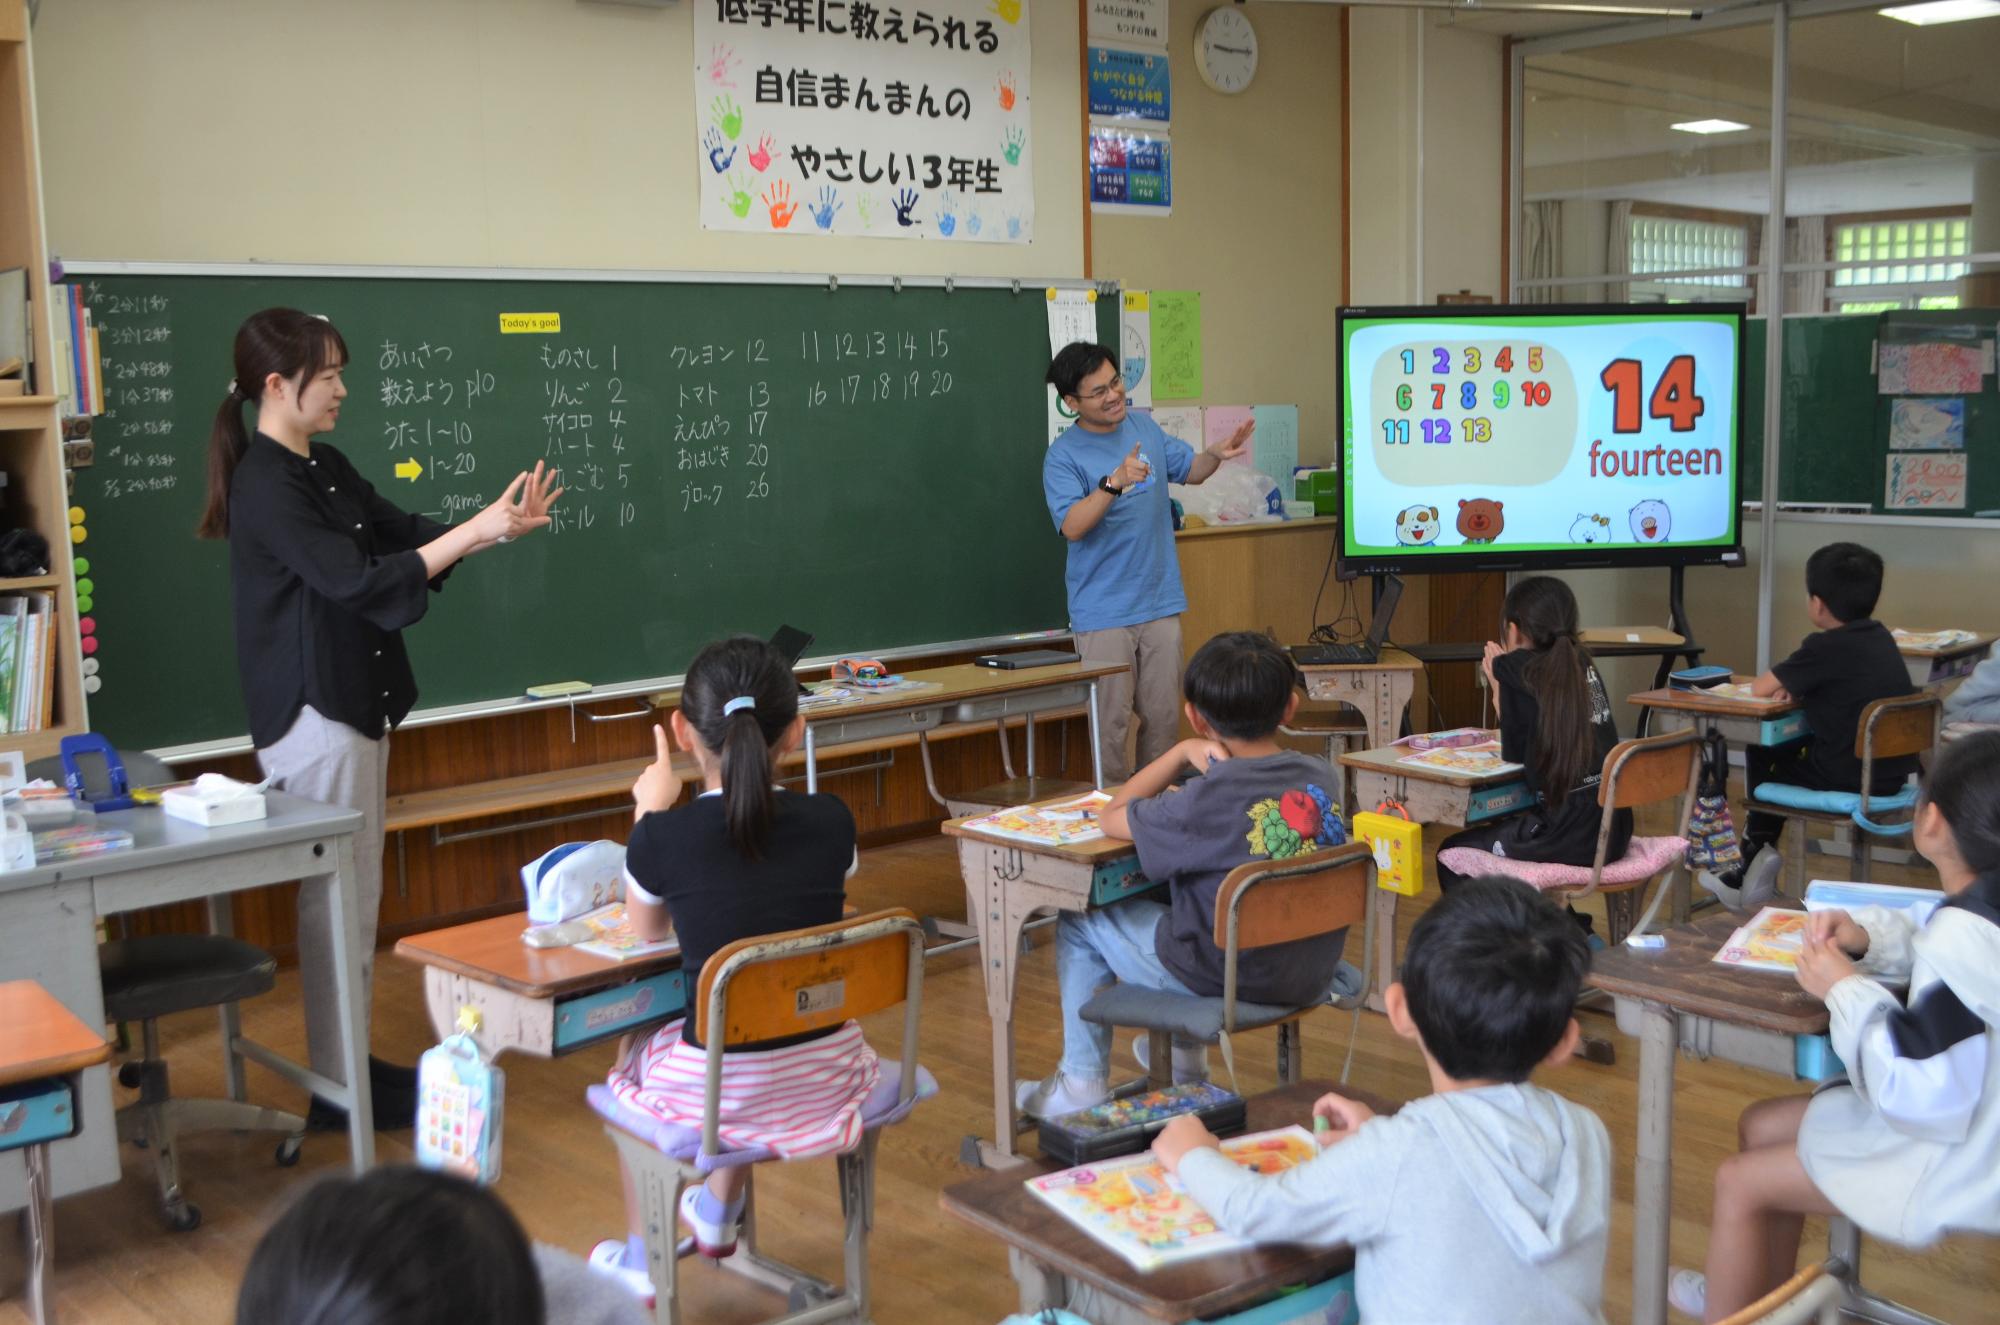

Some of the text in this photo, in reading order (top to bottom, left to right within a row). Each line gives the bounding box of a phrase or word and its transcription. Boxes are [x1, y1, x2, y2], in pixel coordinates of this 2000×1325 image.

[755, 64, 971, 121] 自信まんまんの
[791, 144, 1003, 194] やさしい3年生
[502, 317, 559, 329] Today's goal
[379, 339, 452, 370] あいさつ
[540, 343, 599, 370] ものさし
[670, 339, 769, 369] クレヨン 12
[802, 329, 949, 363] 11 12 13 14 15
[1400, 346, 1544, 374] 1 2 3 4 5
[381, 377, 454, 406] 数えよう
[545, 377, 628, 407] りんご 2
[679, 381, 770, 408] トマト 13
[808, 370, 952, 408] 16 17 18 19 20
[1396, 380, 1551, 411] 6 7 8 9 10
[1599, 354, 1705, 434] 14
[384, 421, 419, 450] うた
[541, 410, 627, 434] サイコロ 4
[674, 411, 768, 442] えんぴつ 17
[1382, 417, 1492, 444] 11 12 13
[545, 432, 625, 457] ハート 4
[677, 443, 768, 470] おはじき 20
[1588, 439, 1723, 477] fourteen
[617, 463, 632, 489] 5
[681, 471, 769, 512] ブロック 26
[441, 493, 488, 525] game
[620, 502, 635, 527] 10
